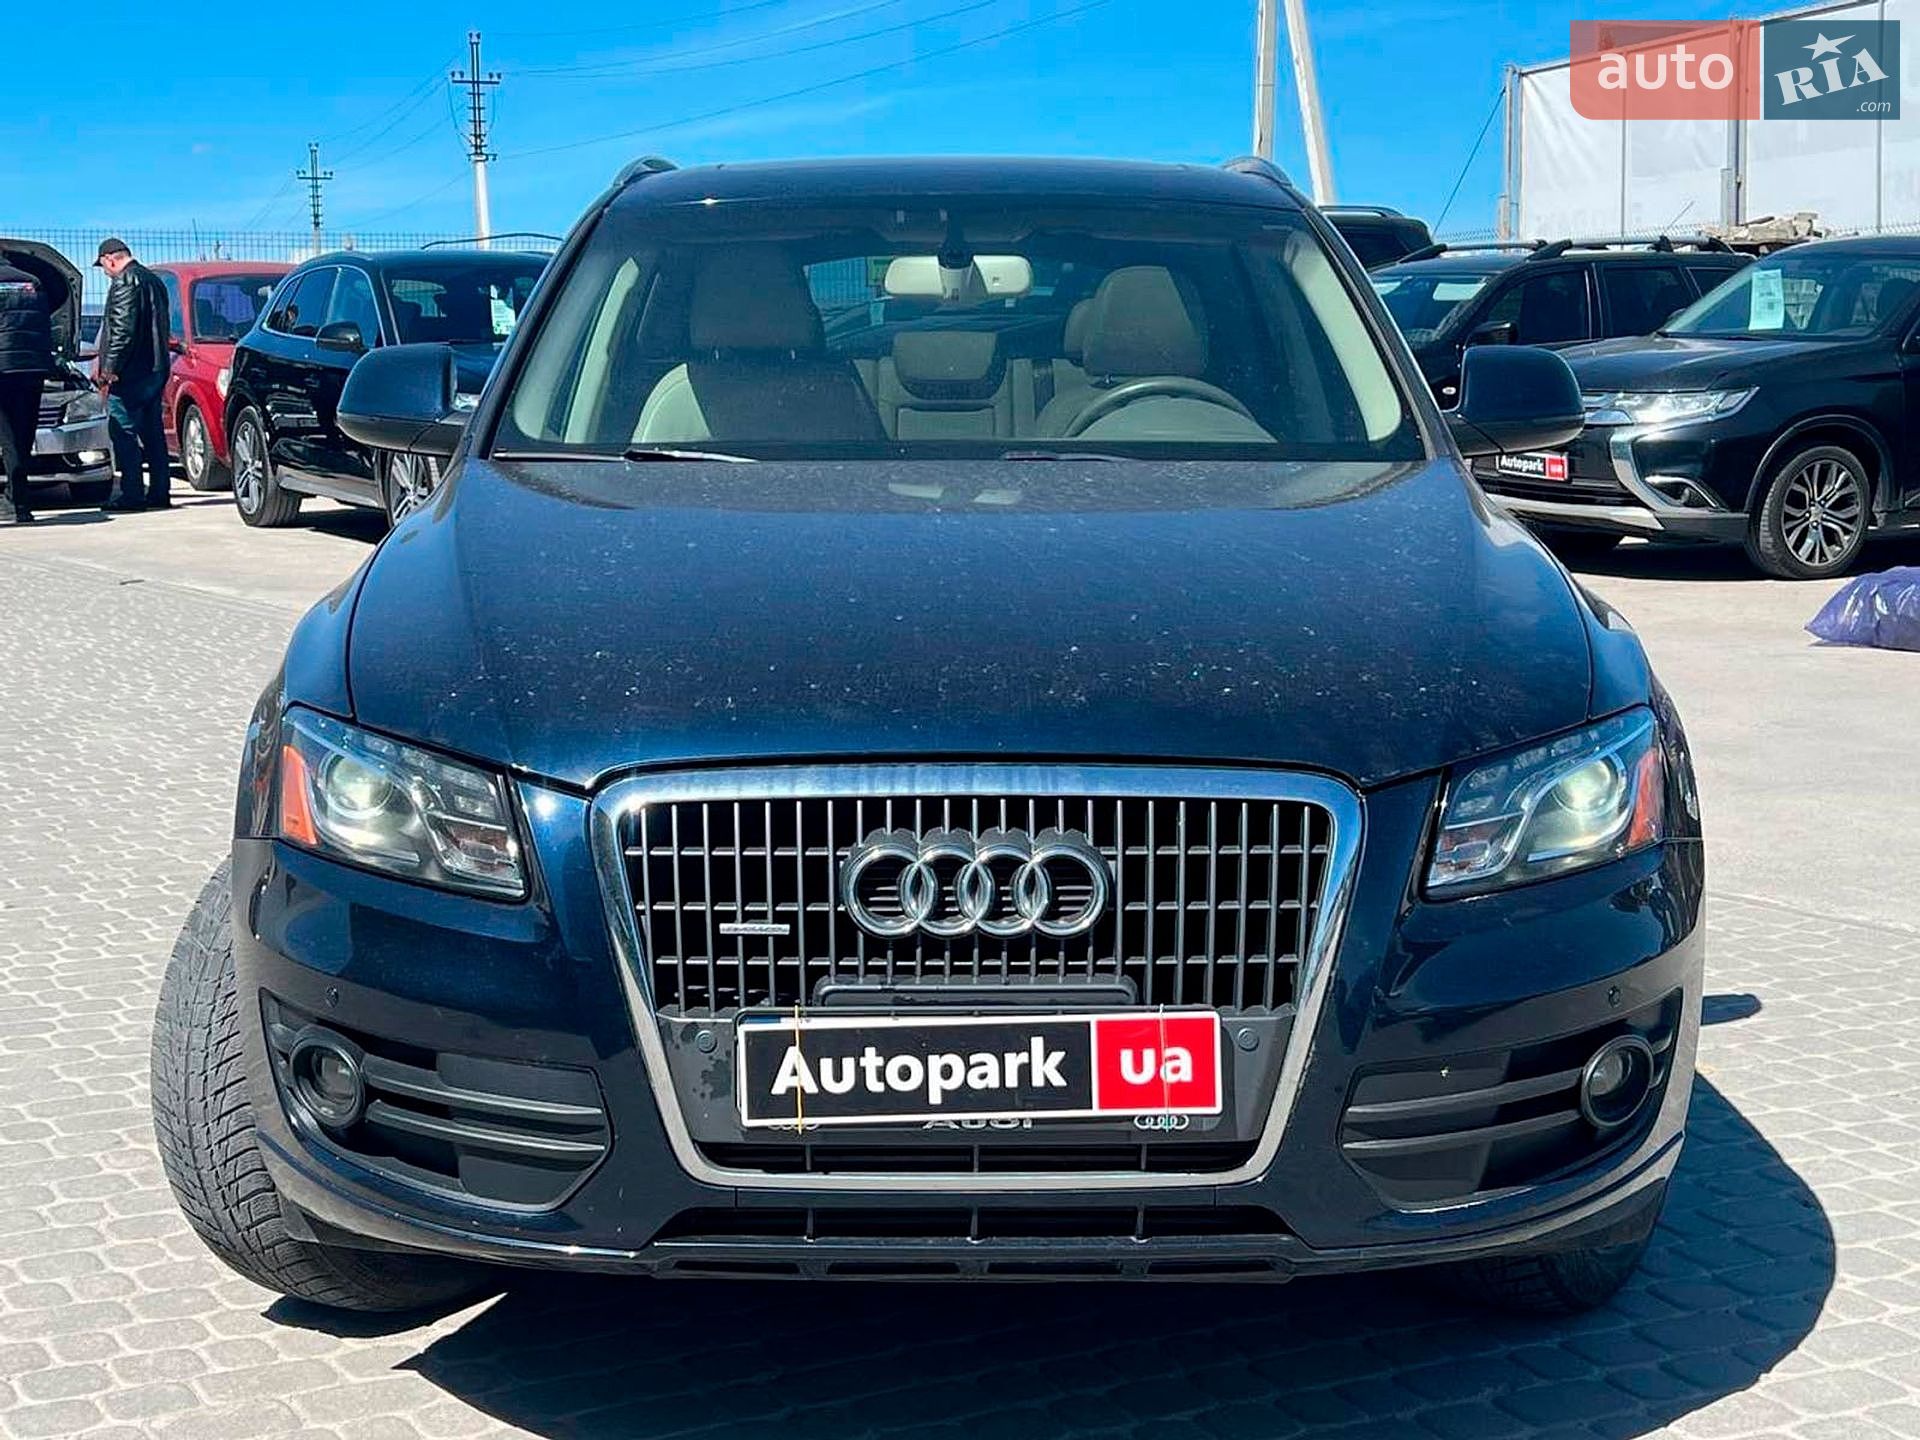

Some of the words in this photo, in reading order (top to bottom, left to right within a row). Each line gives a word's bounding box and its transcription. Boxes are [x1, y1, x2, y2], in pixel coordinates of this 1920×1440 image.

[1500, 454, 1544, 472] Autopark
[770, 1036, 1068, 1105] Autopark
[1119, 1046, 1193, 1085] ua
